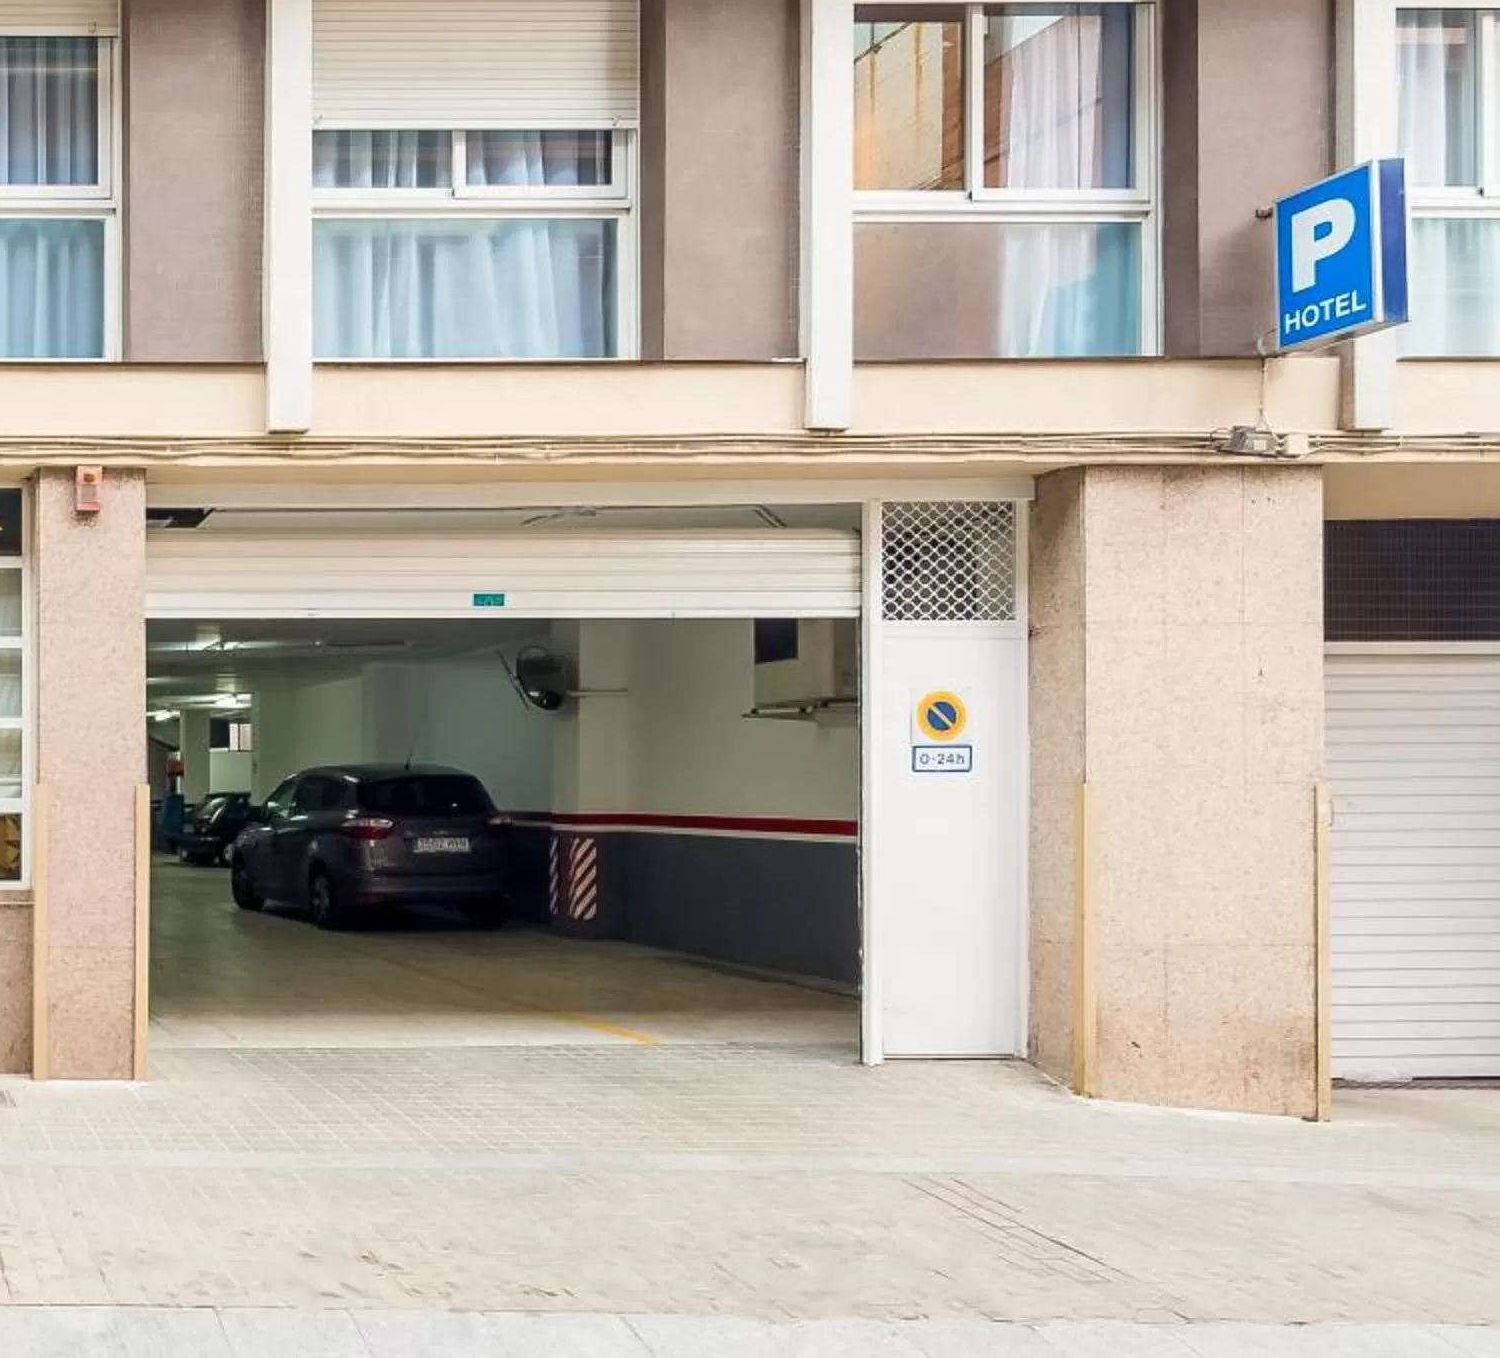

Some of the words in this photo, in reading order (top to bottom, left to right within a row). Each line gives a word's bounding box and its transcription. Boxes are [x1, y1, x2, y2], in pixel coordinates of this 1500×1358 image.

[1292, 197, 1356, 293] P
[1285, 291, 1367, 334] HOTEL
[919, 753, 965, 765] 0-24h
